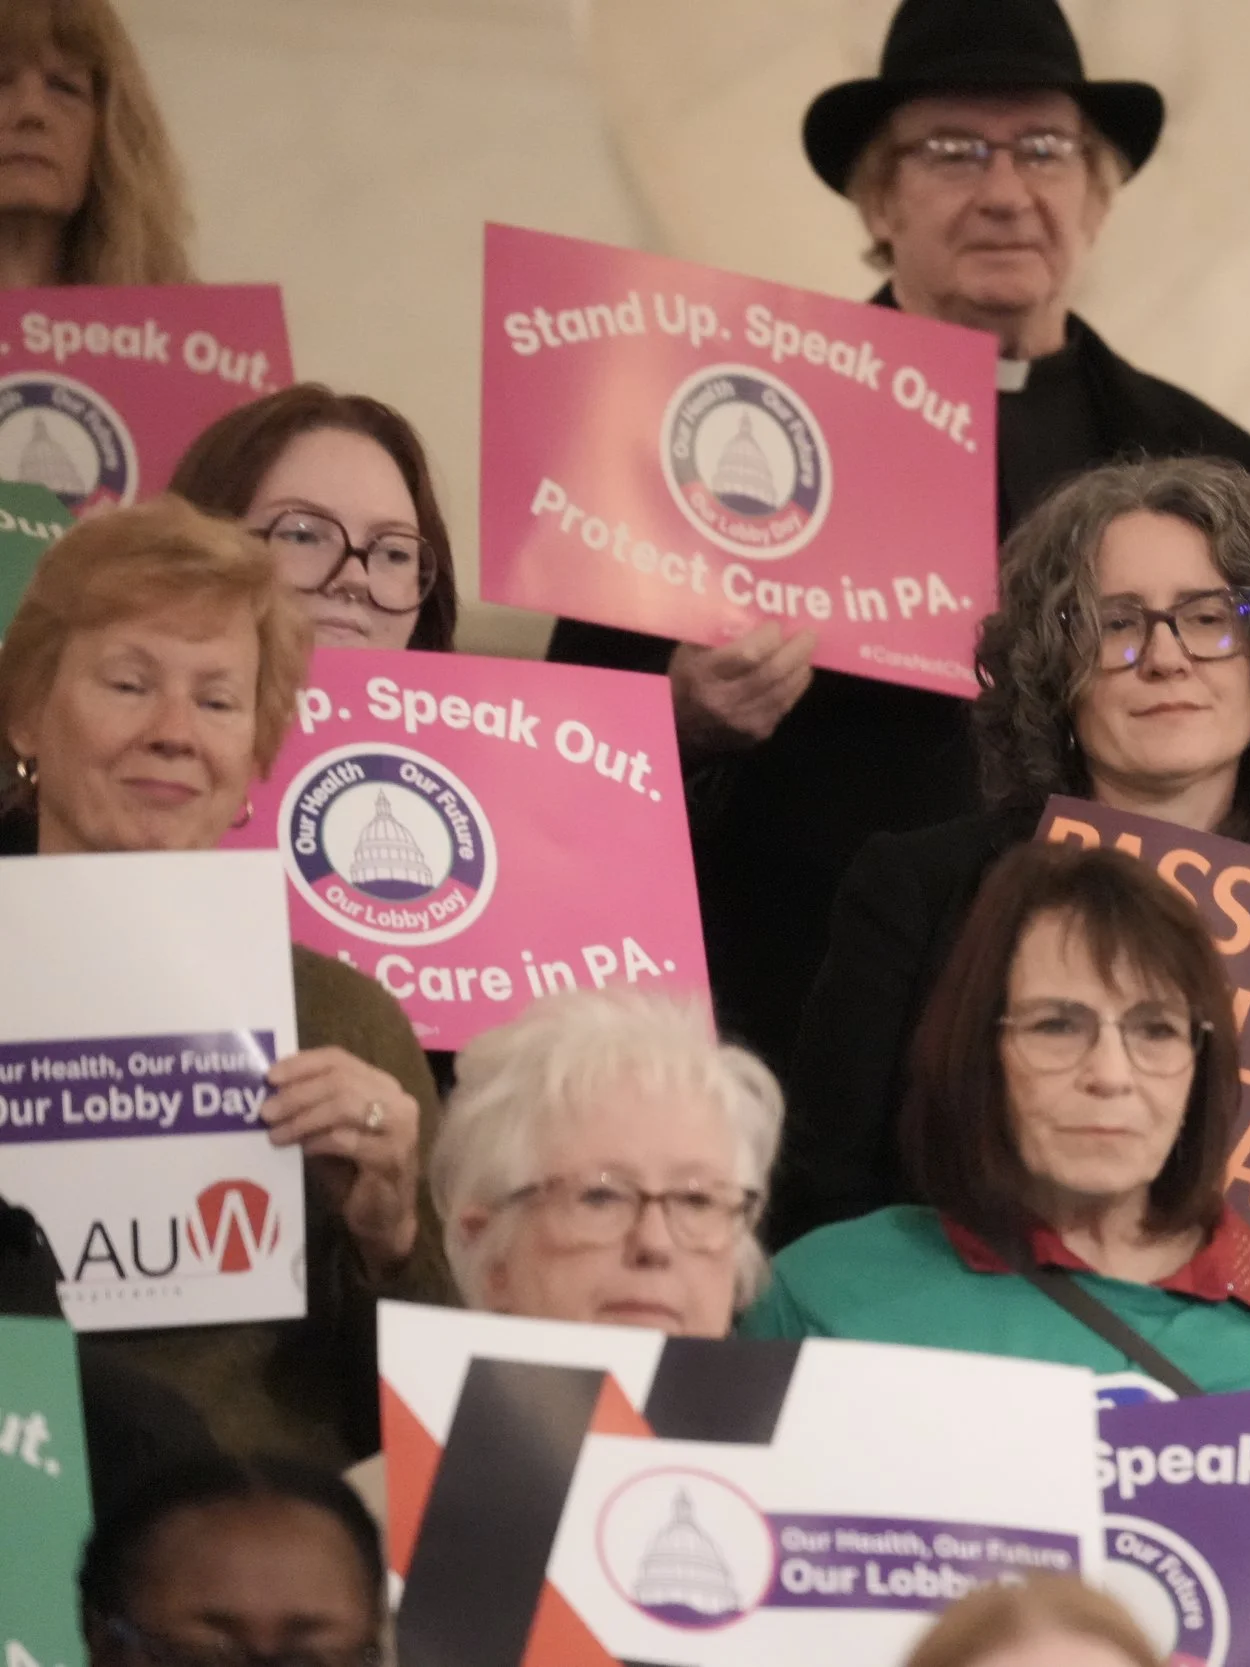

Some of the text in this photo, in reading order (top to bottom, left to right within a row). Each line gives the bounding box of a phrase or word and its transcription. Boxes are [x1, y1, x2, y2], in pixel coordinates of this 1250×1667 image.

[21, 312, 171, 364] Speak
[504, 291, 978, 453] Stand Up. Speak Out.
[530, 478, 973, 622] Protect Care in PA.
[296, 676, 662, 802] p. Speak Out.
[295, 760, 366, 855] Our Health
[400, 762, 475, 861] Our Future
[325, 885, 466, 932] Our Lobby Day
[375, 936, 677, 1002] Care in PA.
[0, 1048, 255, 1085] ur Health, Our Futur
[0, 1081, 267, 1128] ur Lobby Day
[779, 1556, 860, 1595] Our
[1115, 1530, 1205, 1630] Our Future
